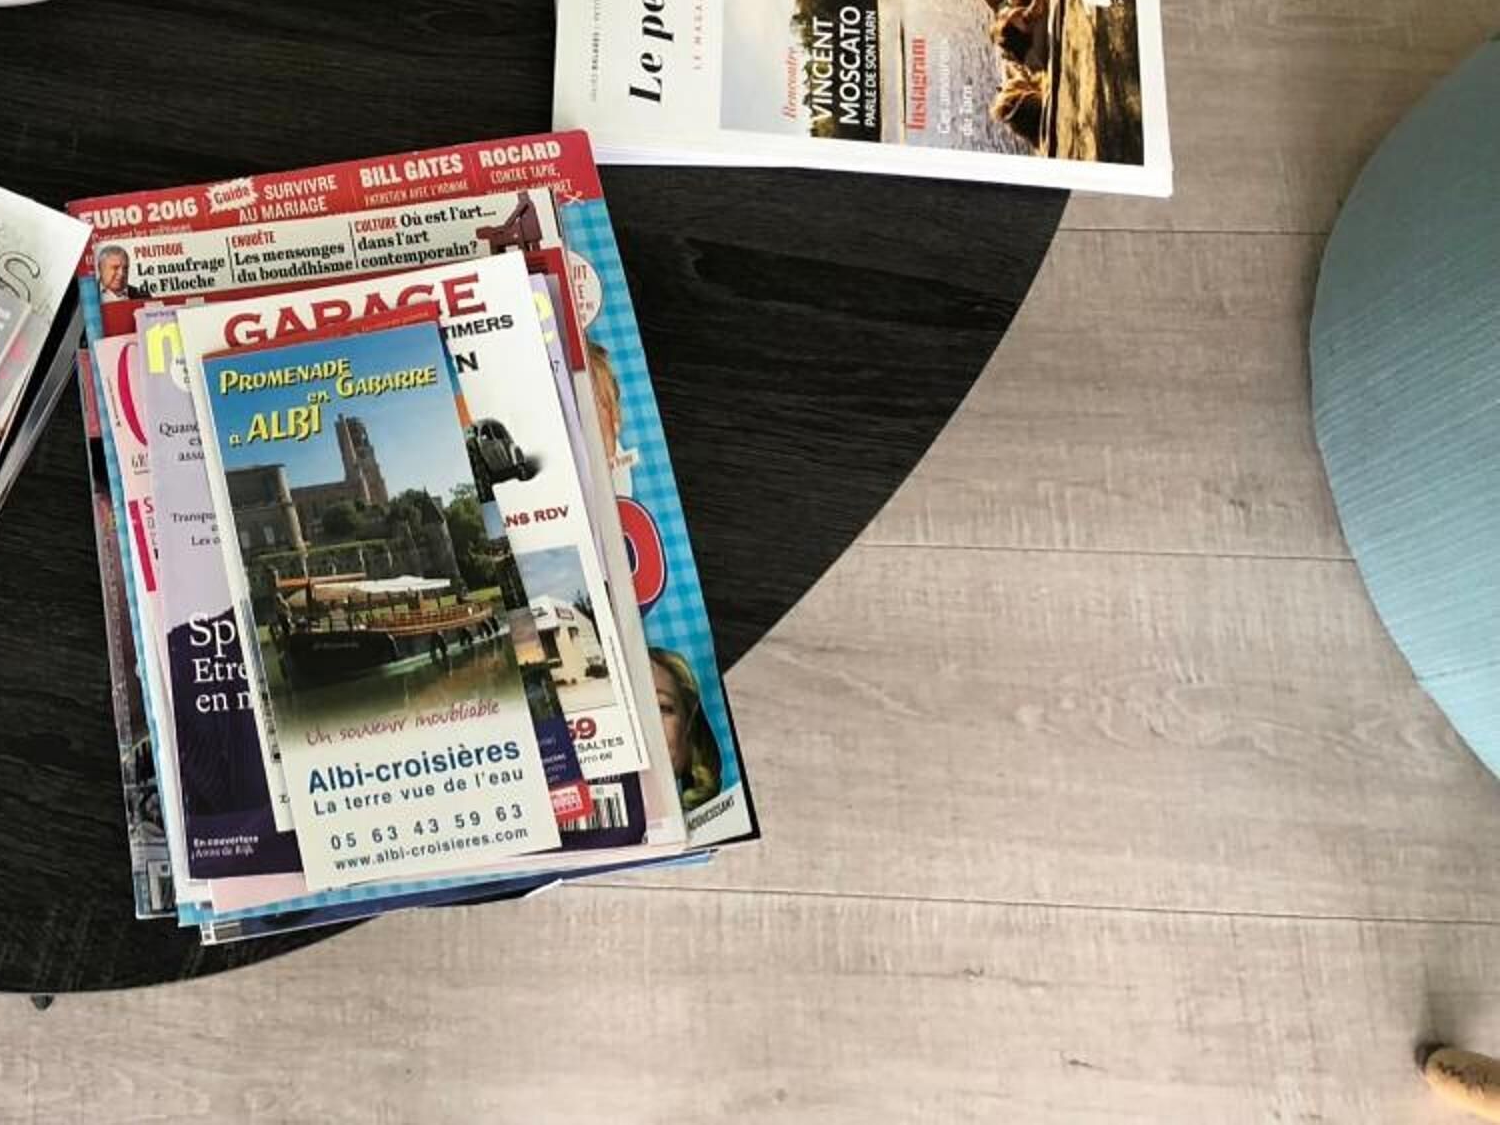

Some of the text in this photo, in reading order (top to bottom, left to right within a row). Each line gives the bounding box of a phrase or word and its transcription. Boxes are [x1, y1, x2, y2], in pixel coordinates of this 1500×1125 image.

[628, 50, 663, 102] Le
[811, 16, 833, 121] VINCENT
[839, 4, 861, 125] MOSCATO
[864, 9, 876, 126] PARLE DE SON TARN
[906, 36, 927, 130] Instagram
[478, 140, 563, 169] ROCARD
[359, 153, 465, 188] BILL GATES
[212, 185, 251, 206] Guide
[262, 173, 339, 201] SURVIVRE
[145, 196, 200, 223] 2016
[237, 195, 327, 223] AU MARIAGE
[353, 215, 398, 234] CULTURE
[398, 210, 423, 227] Où
[423, 209, 446, 223] est
[133, 241, 185, 260] POLITIQUE
[233, 240, 346, 266] Les mensonges
[356, 228, 429, 251] dans l'art
[136, 251, 226, 278] Le naufrage
[236, 255, 353, 283] du bouddhisme
[359, 240, 480, 270] contemporain?
[140, 271, 216, 294] de Filoche
[218, 357, 351, 397] PROMENADE
[307, 362, 439, 404] en GABARRE
[246, 404, 323, 446] ALBI
[533, 506, 571, 523] RDV
[194, 691, 230, 715] en
[304, 697, 503, 748] Un souvenir inoubliable
[307, 737, 522, 795] Albi-croisières
[312, 764, 525, 817] La terre vue de l'eau
[328, 801, 525, 852] 05 63 43 59 63
[333, 825, 530, 871] www.albi-croisieres.com
